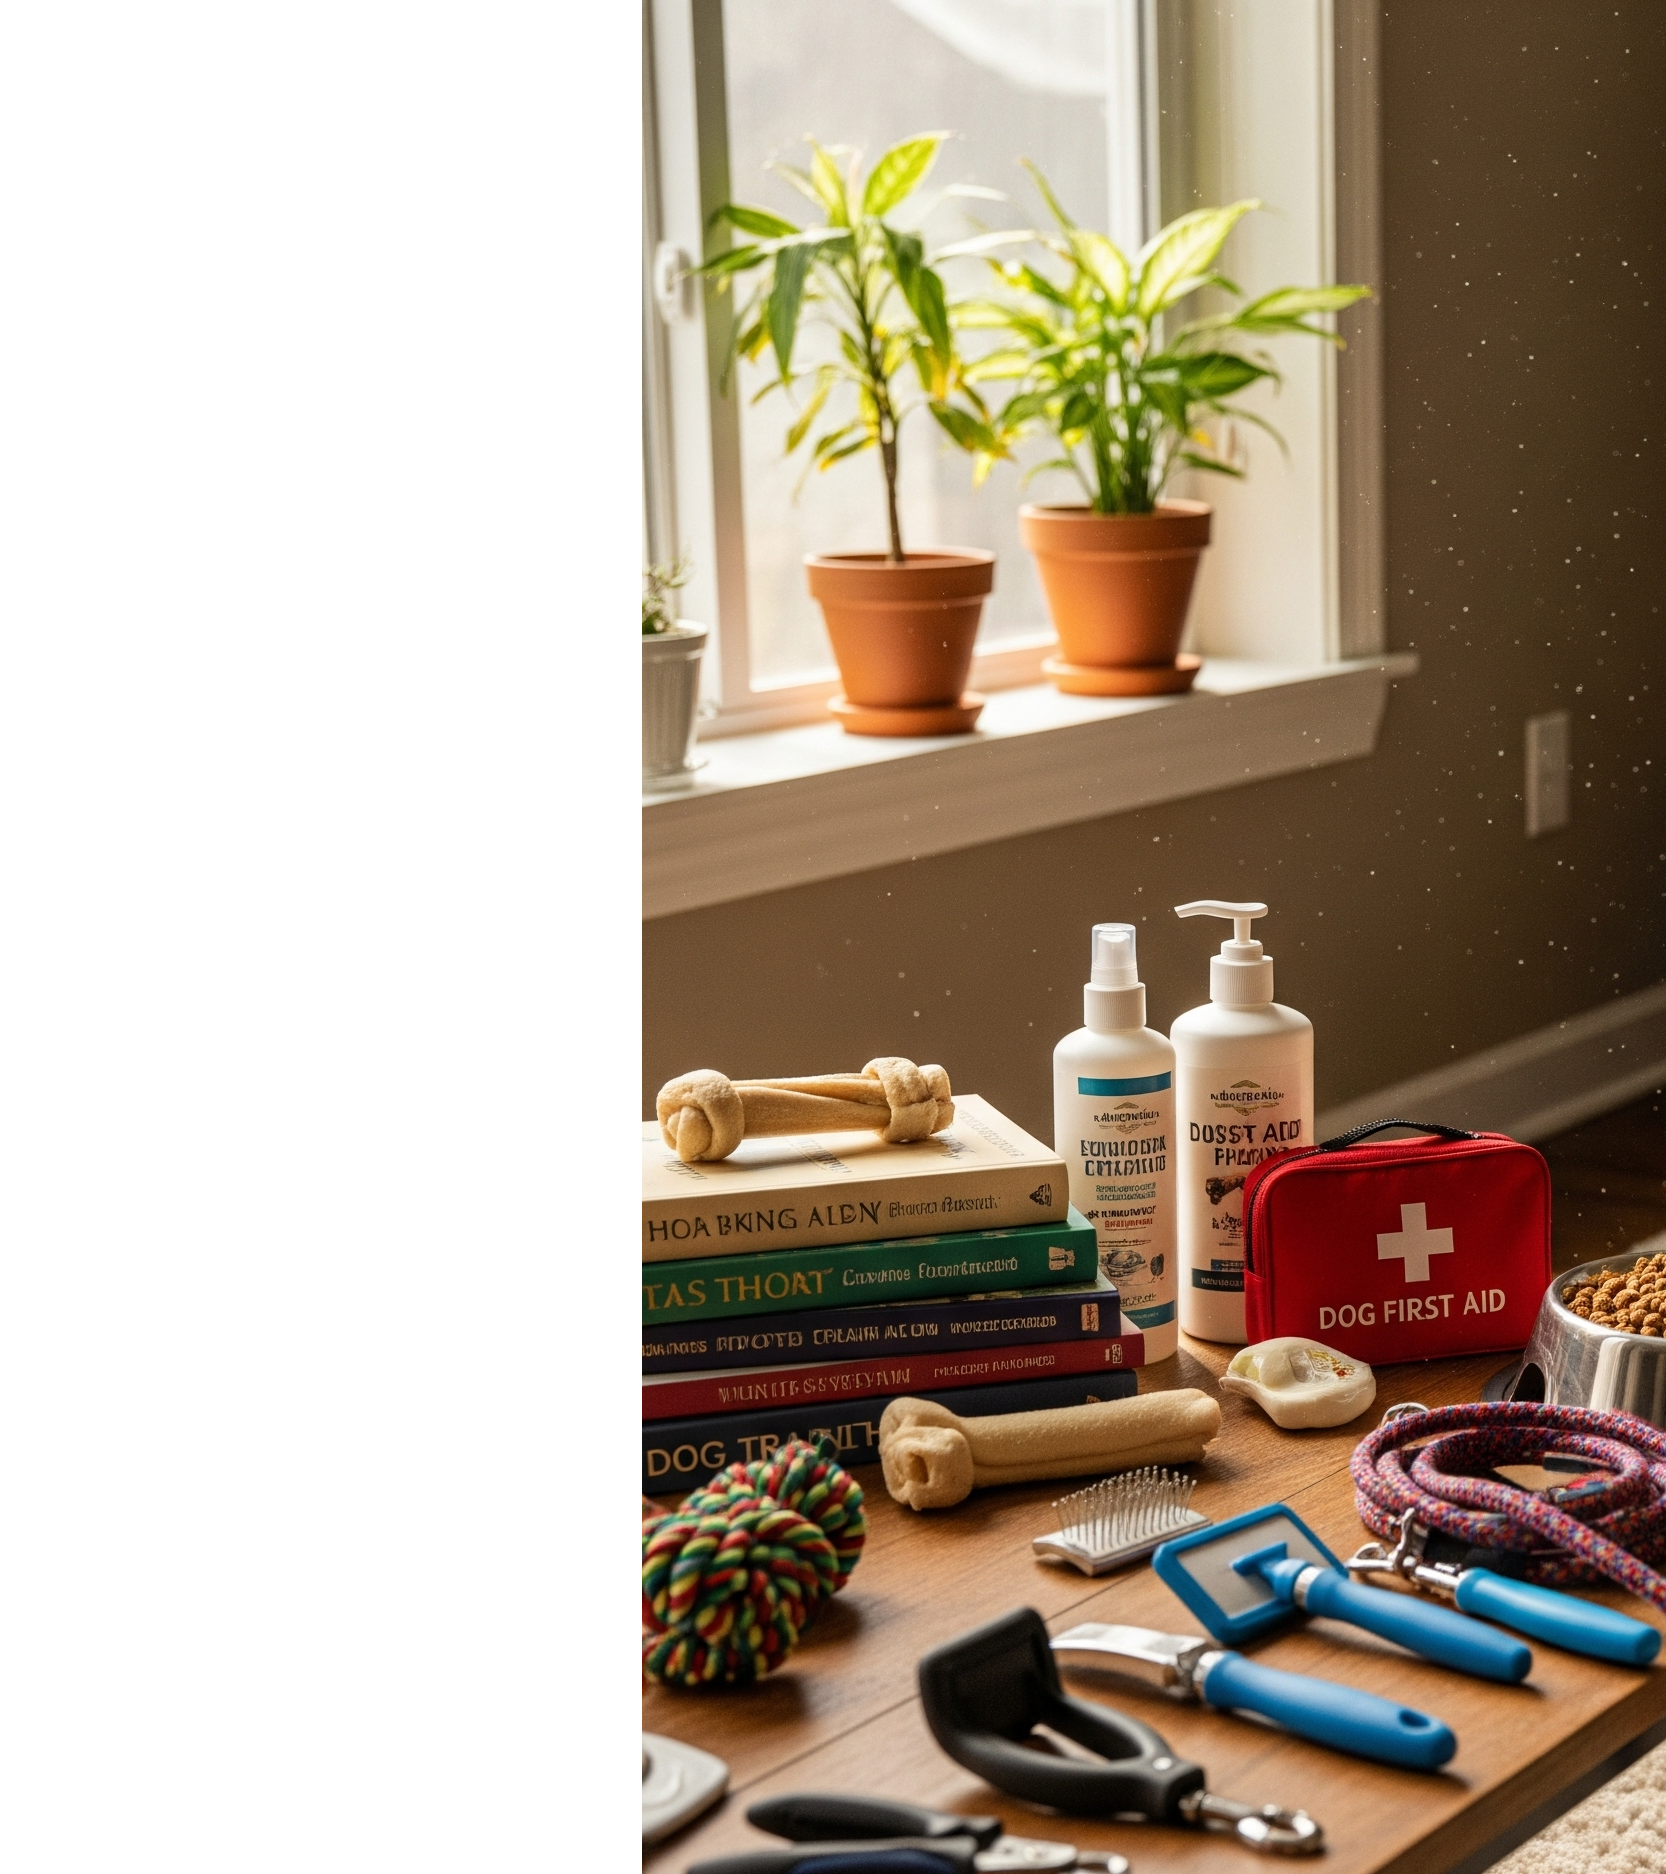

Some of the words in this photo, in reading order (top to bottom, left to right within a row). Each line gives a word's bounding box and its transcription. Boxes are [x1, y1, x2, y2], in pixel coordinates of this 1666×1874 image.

[1319, 1303, 1376, 1330] DOG
[1384, 1294, 1454, 1324] FIRST
[1463, 1288, 1506, 1316] AID
[647, 1440, 726, 1477] DOG
